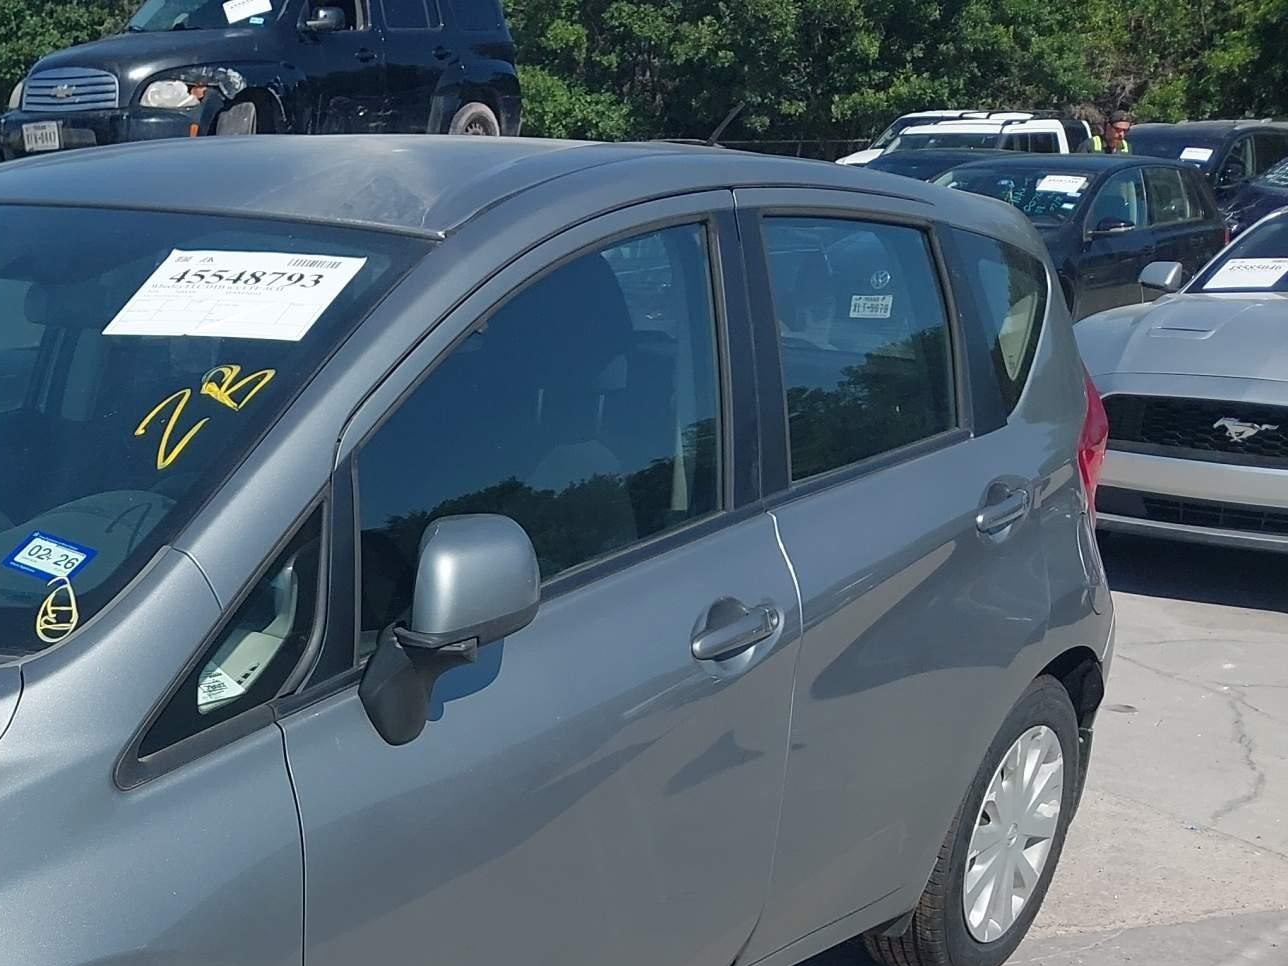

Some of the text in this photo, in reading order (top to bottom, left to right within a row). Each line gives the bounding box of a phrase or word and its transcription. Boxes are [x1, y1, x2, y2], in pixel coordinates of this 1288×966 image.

[169, 268, 325, 288] 45548793
[28, 544, 52, 561] 02
[53, 553, 79, 570] 26
